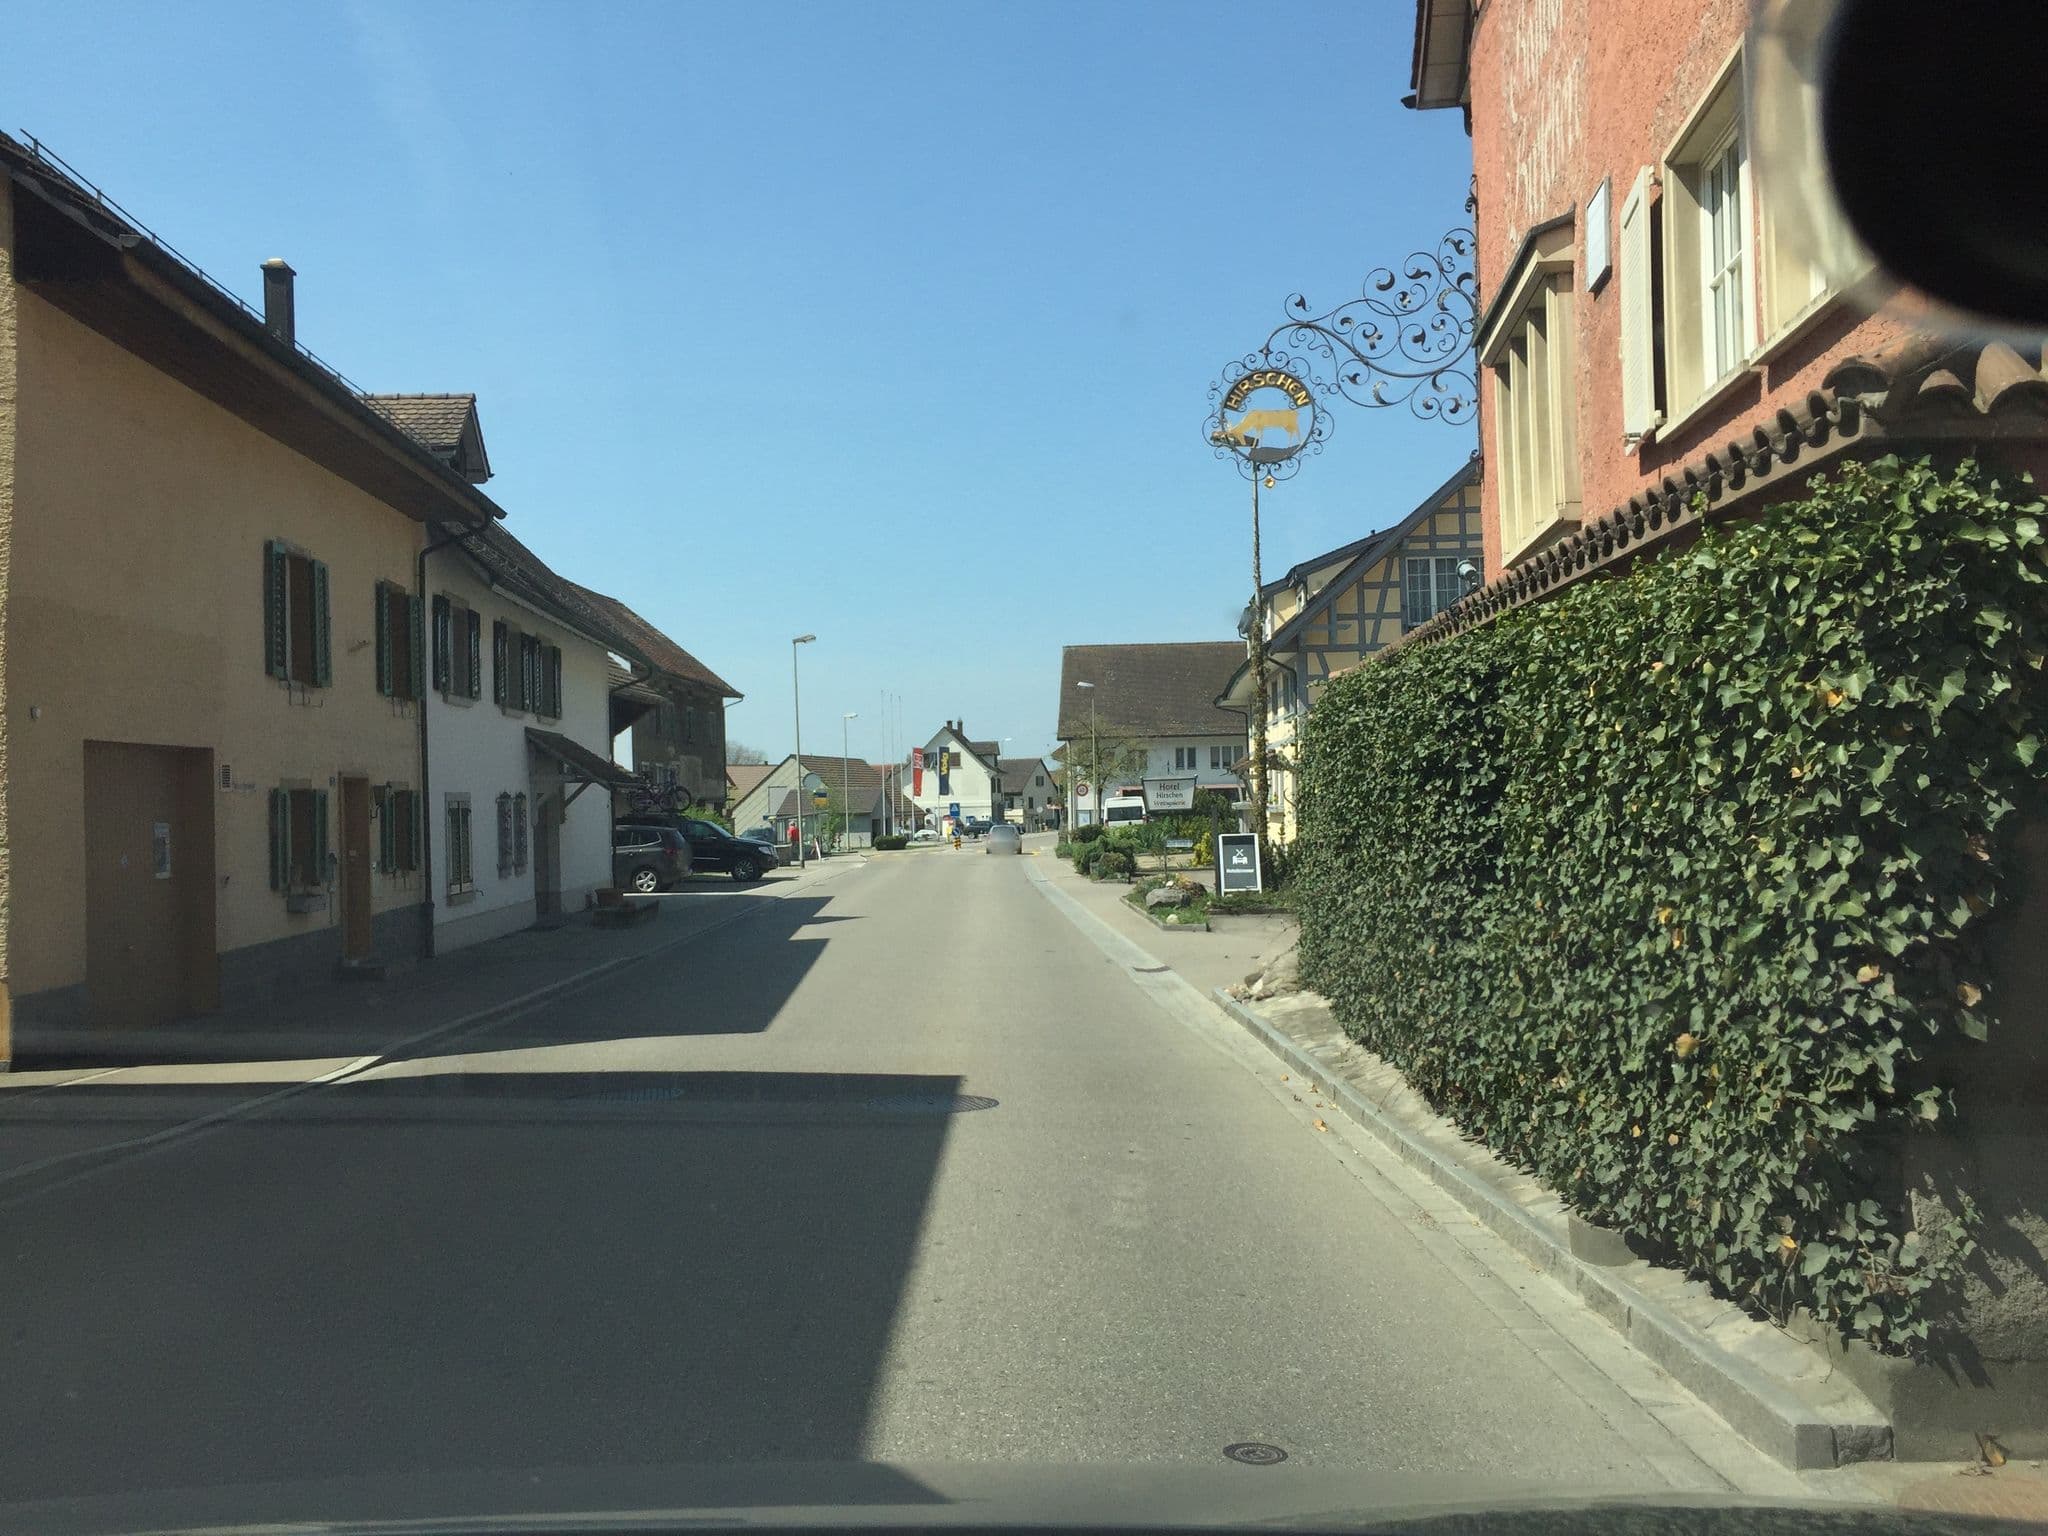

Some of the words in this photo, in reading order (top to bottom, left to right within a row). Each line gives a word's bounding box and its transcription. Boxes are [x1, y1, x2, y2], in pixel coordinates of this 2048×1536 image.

[1226, 372, 1310, 409] HIRSCHEN
[1159, 783, 1180, 791] Hotel
[1156, 791, 1183, 799] Hirschen
